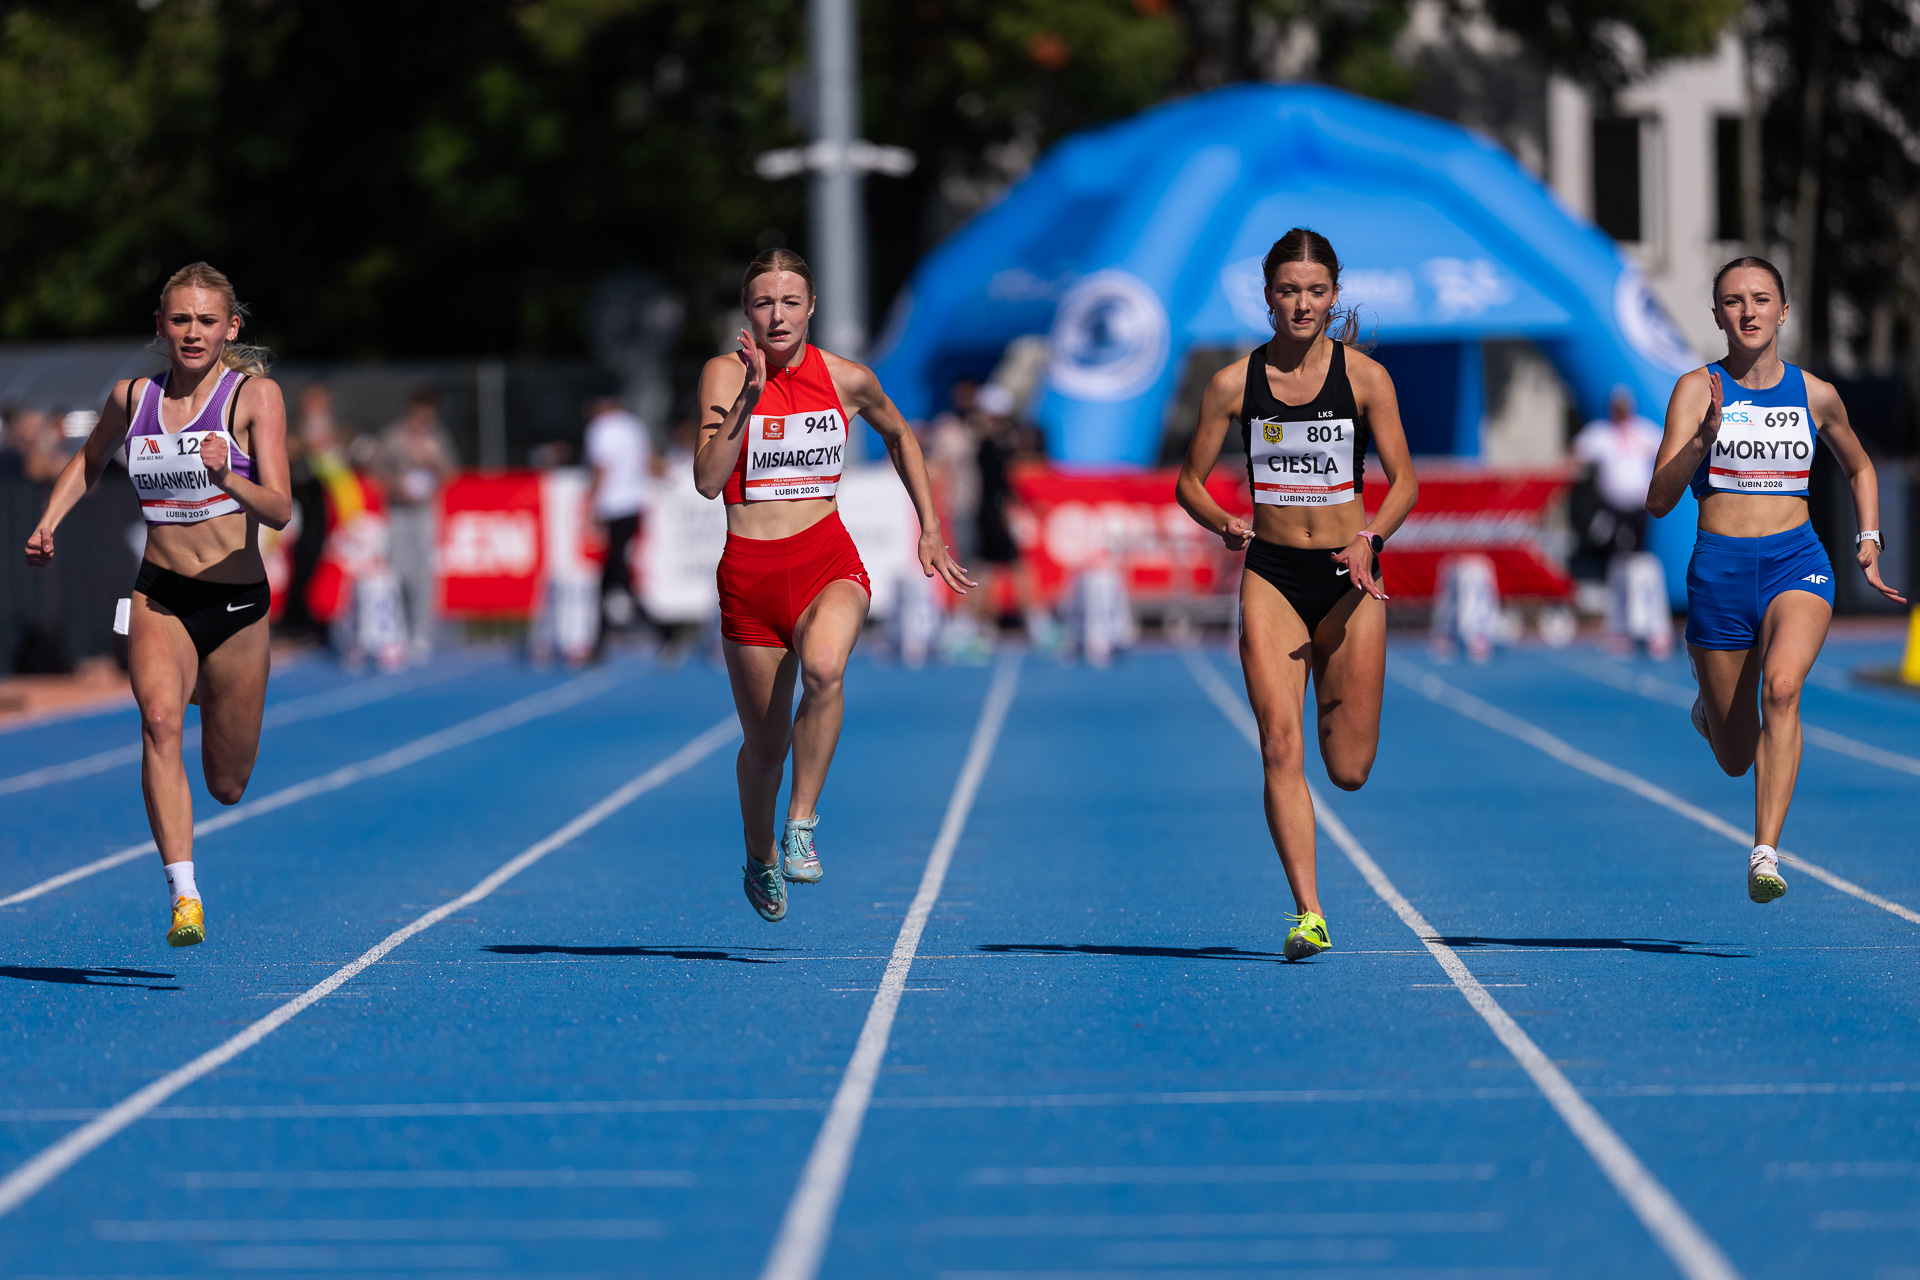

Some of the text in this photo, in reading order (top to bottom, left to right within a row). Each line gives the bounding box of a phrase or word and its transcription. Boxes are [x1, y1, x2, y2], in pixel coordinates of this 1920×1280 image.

[1318, 410, 1333, 418] LKS
[1764, 411, 1800, 428] 699
[804, 414, 838, 434] 941
[1307, 425, 1344, 442] 801
[176, 437, 200, 456] 12
[1715, 440, 1809, 460] MORYTO
[752, 444, 842, 470] MISIARCZYK
[1267, 453, 1339, 475] CIEŚLA
[134, 470, 212, 490] ZEMANKIEWI
[800, 486, 820, 494] 2026
[188, 508, 210, 518] 2026
